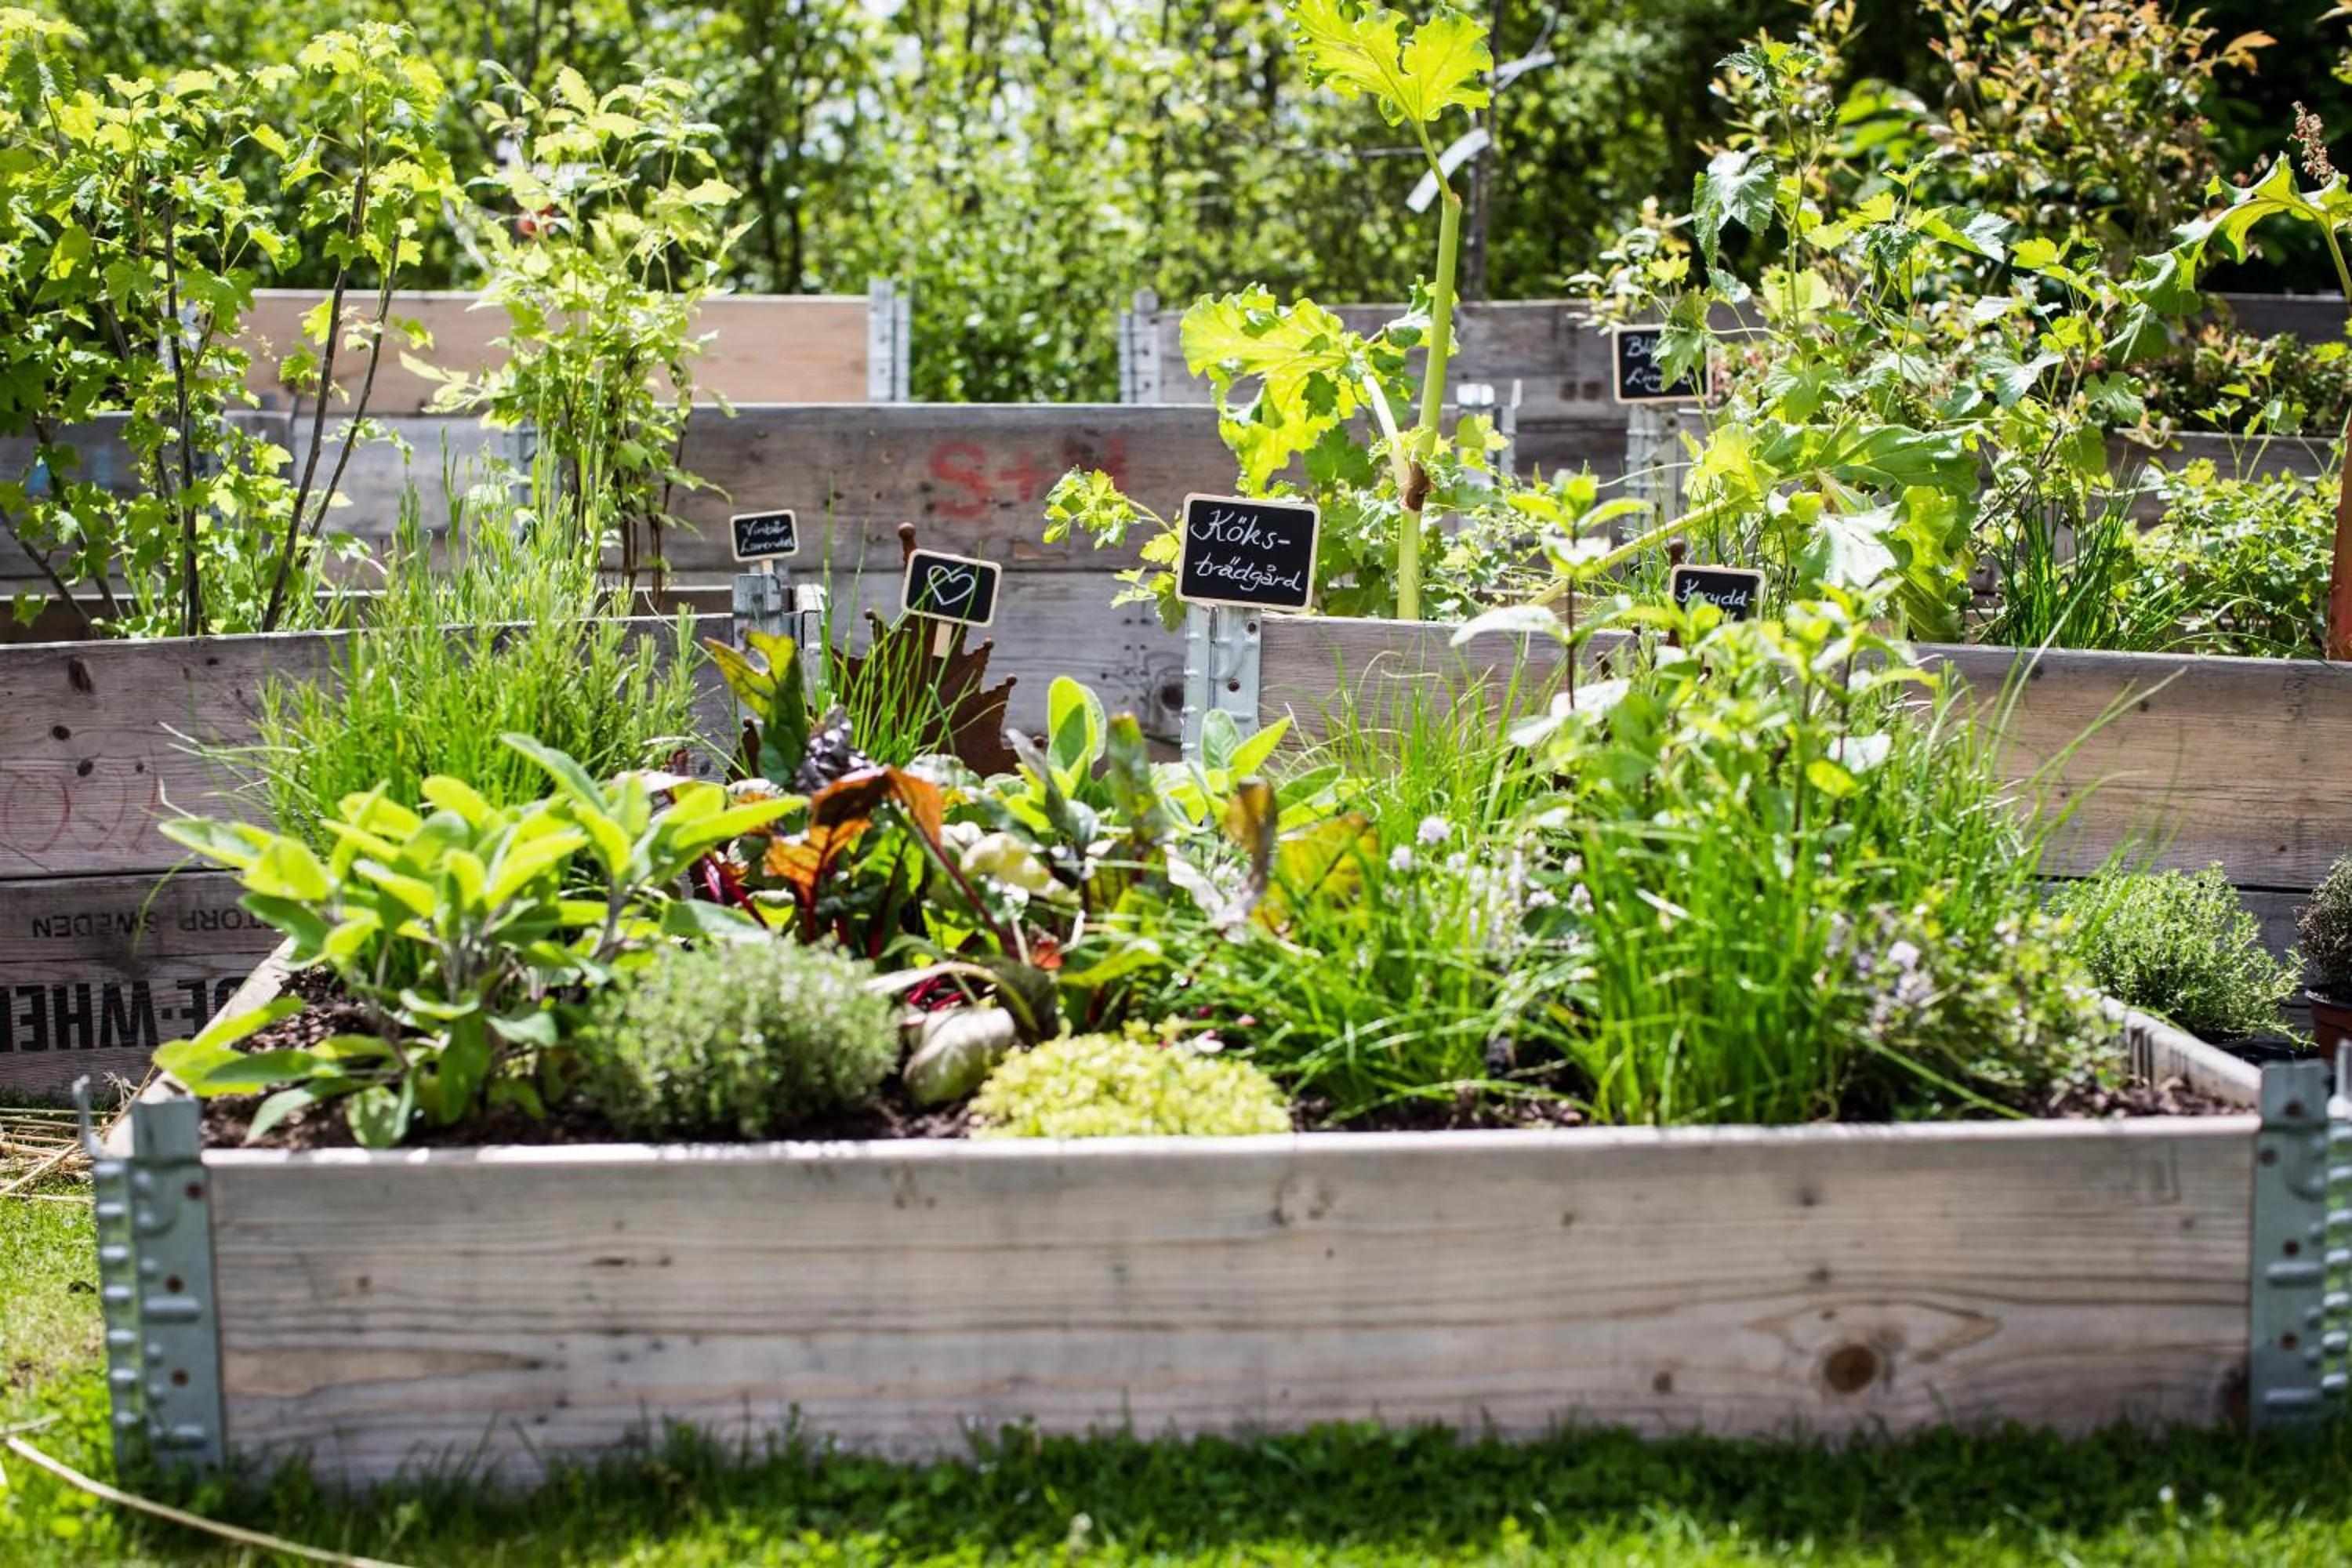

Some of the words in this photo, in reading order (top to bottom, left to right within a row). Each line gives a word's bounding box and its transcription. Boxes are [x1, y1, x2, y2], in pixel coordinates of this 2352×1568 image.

[1189, 507, 1291, 550] Köks-
[1194, 551, 1303, 593] trädgård
[31, 911, 158, 939] SWEDEN
